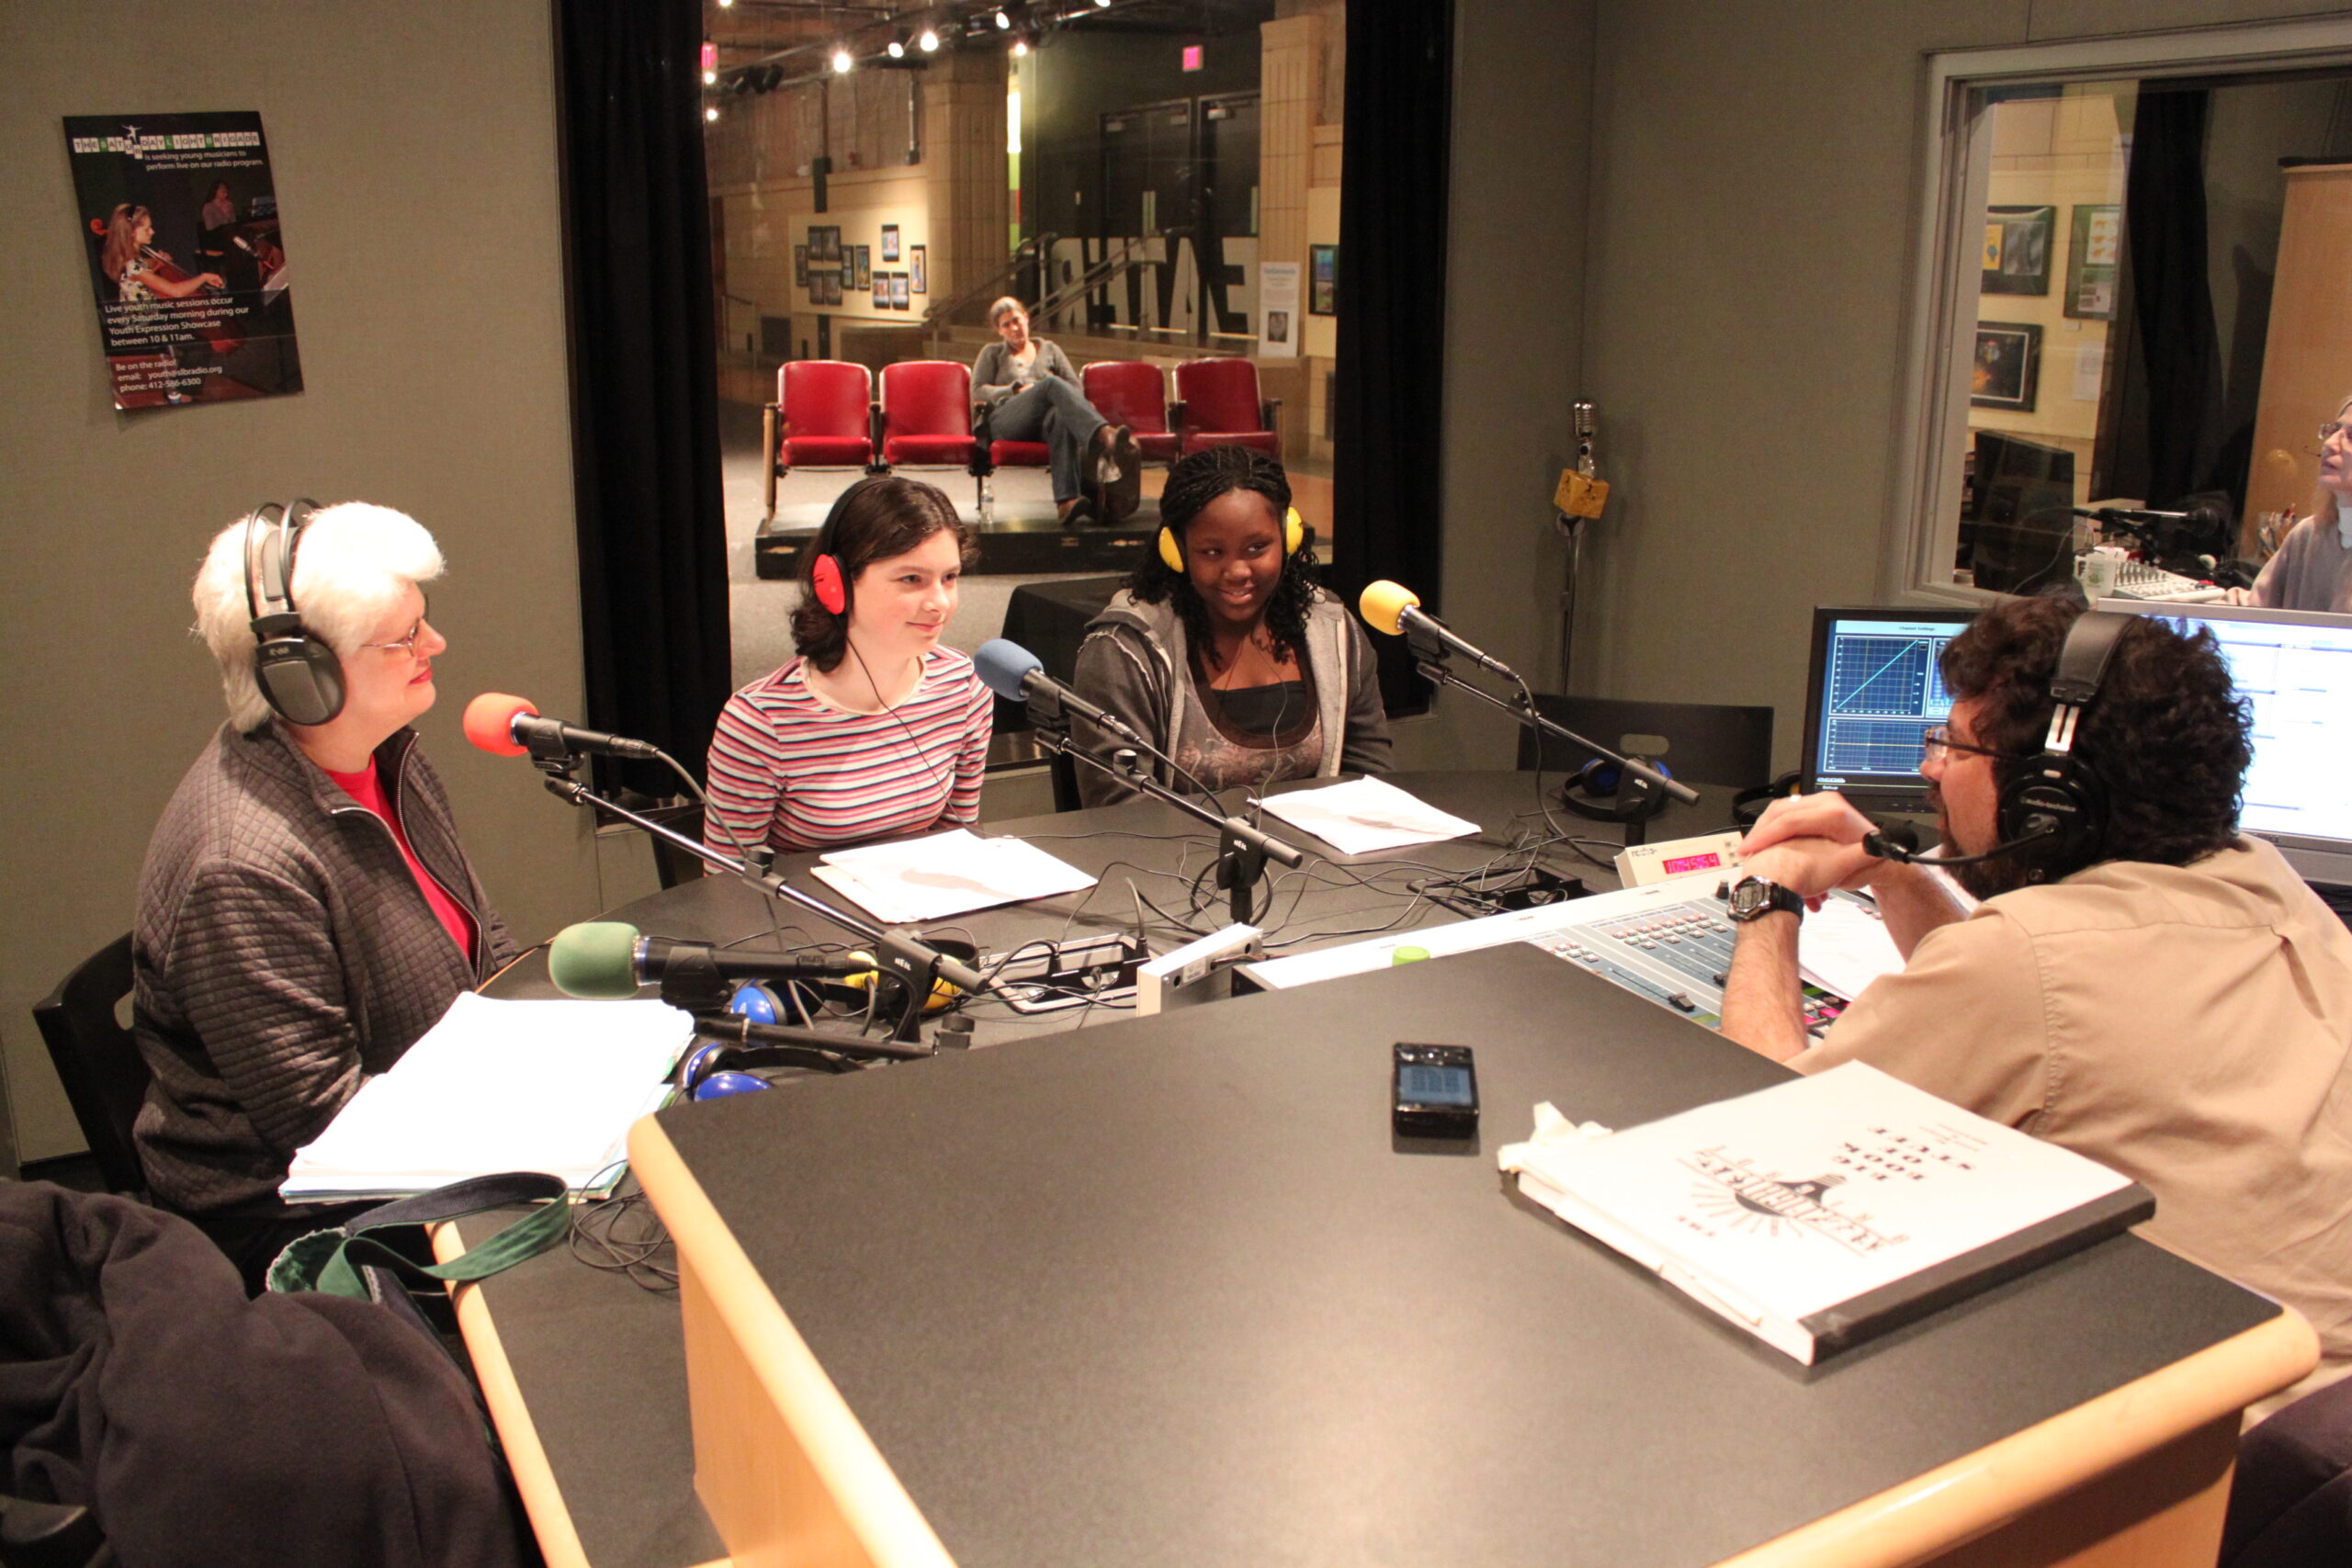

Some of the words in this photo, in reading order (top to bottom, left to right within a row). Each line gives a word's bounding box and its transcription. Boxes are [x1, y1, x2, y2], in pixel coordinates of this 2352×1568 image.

[204, 150, 238, 158] musicians
[146, 162, 175, 172] perform
[176, 161, 189, 169] live
[214, 160, 232, 168] radio
[105, 304, 122, 313] Live
[124, 302, 149, 313] youth
[150, 301, 175, 310] music
[175, 299, 209, 308] sessions
[210, 297, 233, 305] occur
[107, 316, 131, 325] every
[131, 312, 168, 323] Saturday
[170, 309, 205, 320] morning
[207, 307, 233, 317] during
[234, 307, 250, 315] our
[108, 326, 134, 335] Youth
[135, 322, 179, 334] Expression
[181, 321, 221, 330] Showcase
[110, 336, 148, 347] between
[150, 334, 160, 344] 10
[169, 333, 195, 342] 11am.
[115, 363, 126, 372] Be
[127, 363, 139, 371] on
[139, 361, 153, 369] the
[153, 358, 177, 368] radio!
[118, 372, 142, 382] email:
[119, 383, 148, 393] phone:
